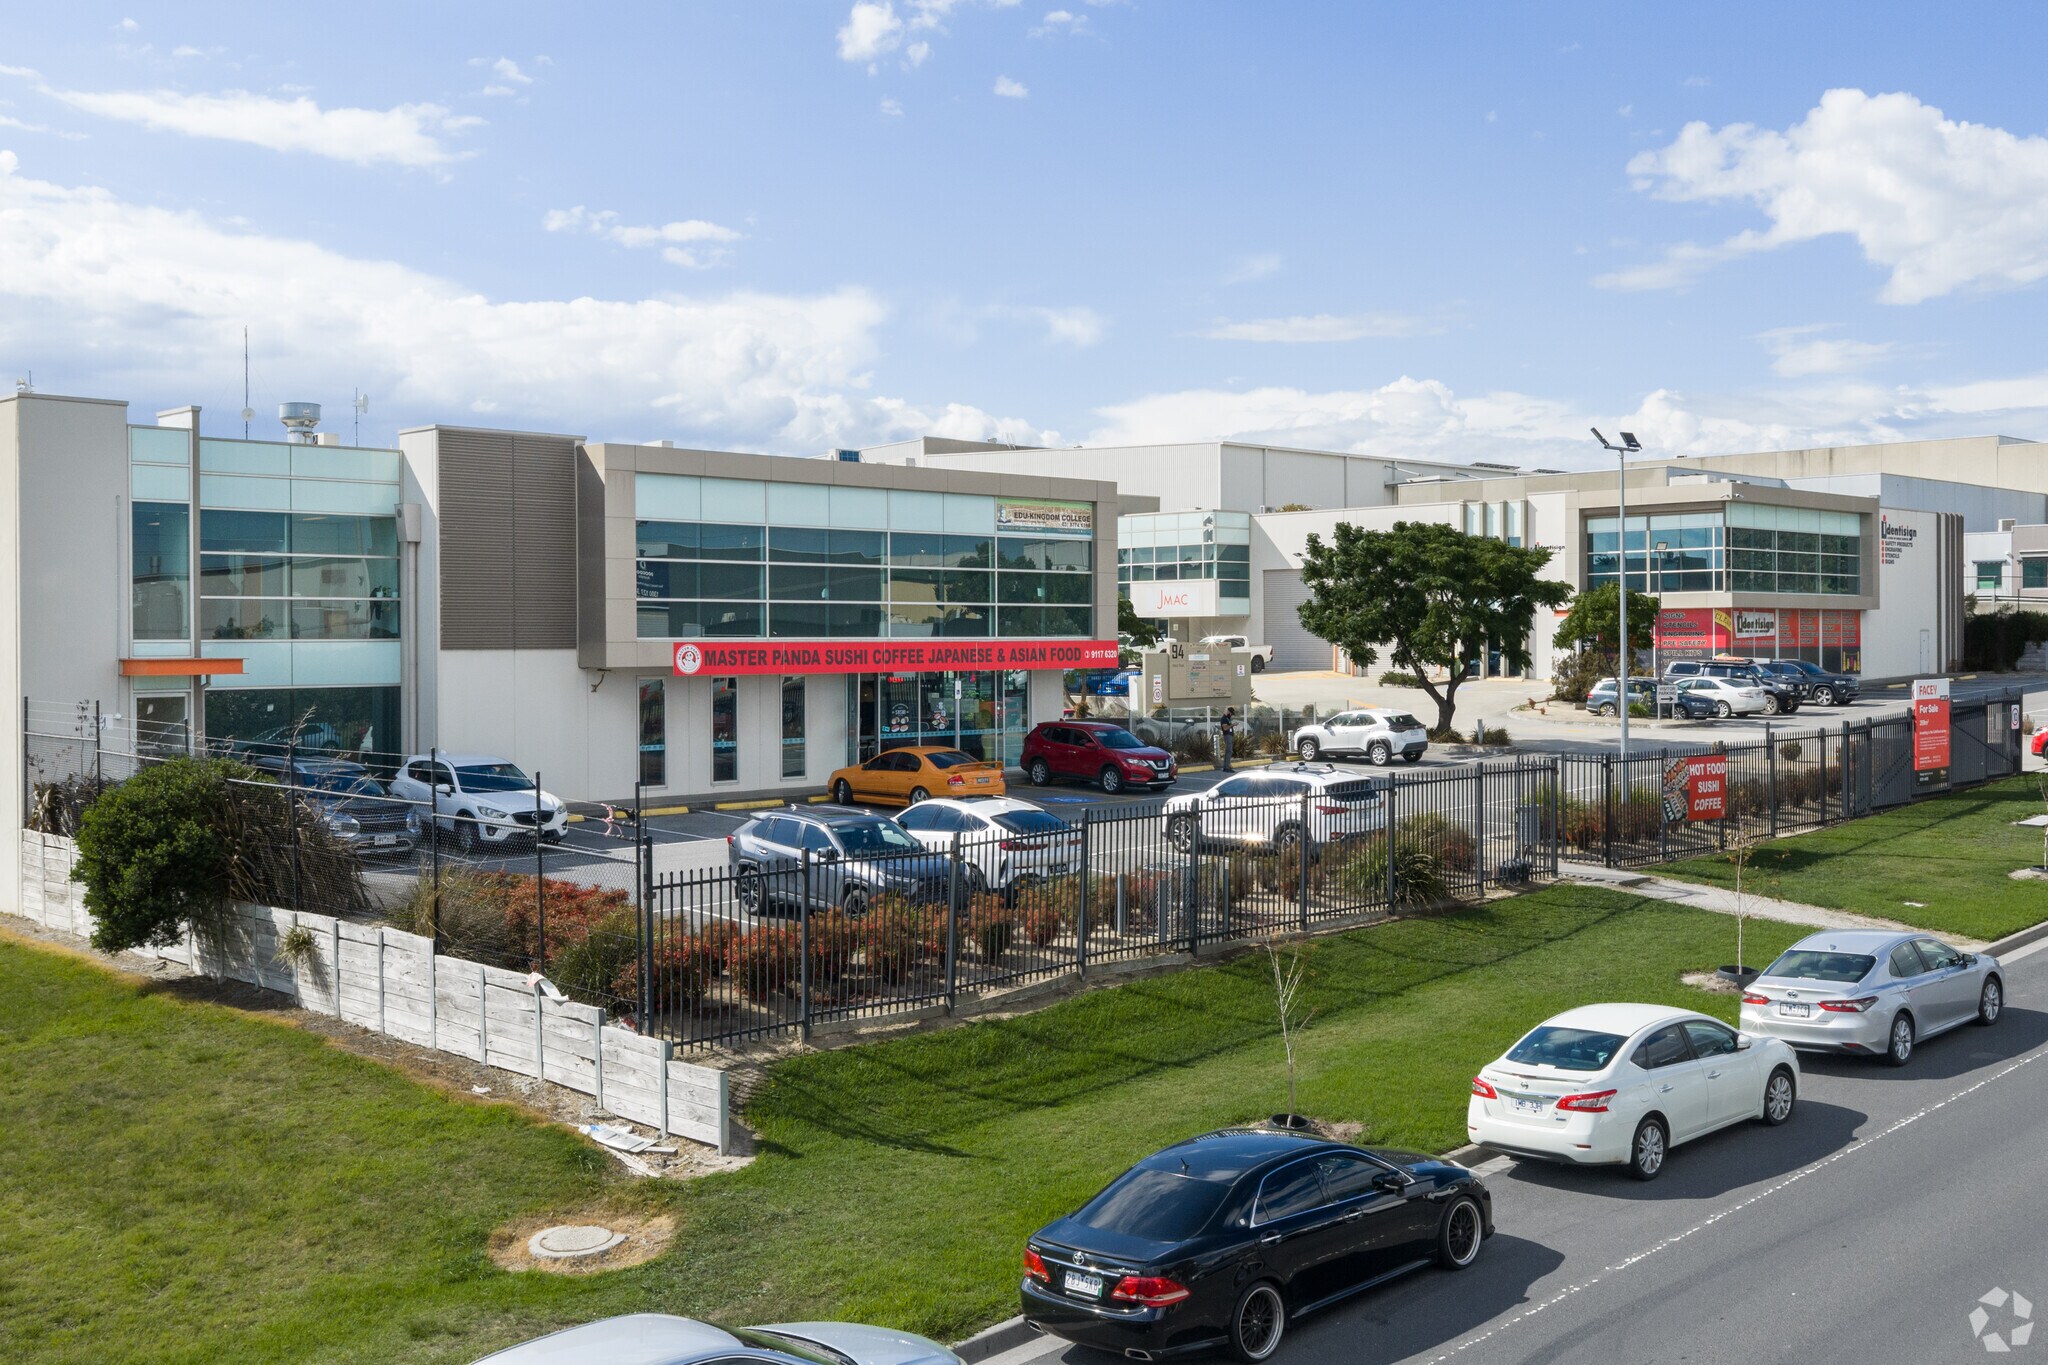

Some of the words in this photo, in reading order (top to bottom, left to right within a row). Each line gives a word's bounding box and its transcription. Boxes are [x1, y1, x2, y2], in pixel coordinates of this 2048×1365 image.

[1014, 511, 1060, 521] EDU-KINGDOM
[1061, 514, 1091, 523] COLLEGE
[1679, 639, 1707, 647] SAFETY
[704, 649, 768, 667] MASTER
[772, 648, 821, 666] PANDA
[825, 648, 868, 666] SUSHI
[872, 648, 925, 665] COFFEE
[928, 647, 993, 664] JAPANESE
[997, 647, 1005, 662] &
[1009, 647, 1046, 663] ASIAN
[1050, 647, 1081, 662] FOOD
[1090, 650, 1104, 659] 9117
[1171, 644, 1185, 659] 94
[1919, 685, 1938, 696] FACEY
[1919, 704, 1929, 714] For
[1928, 703, 1939, 713] Sale
[1689, 763, 1705, 776] HOT
[1706, 762, 1726, 775] FOOD
[1697, 780, 1720, 793] SUSHI
[1694, 797, 1722, 811] COFFEE
